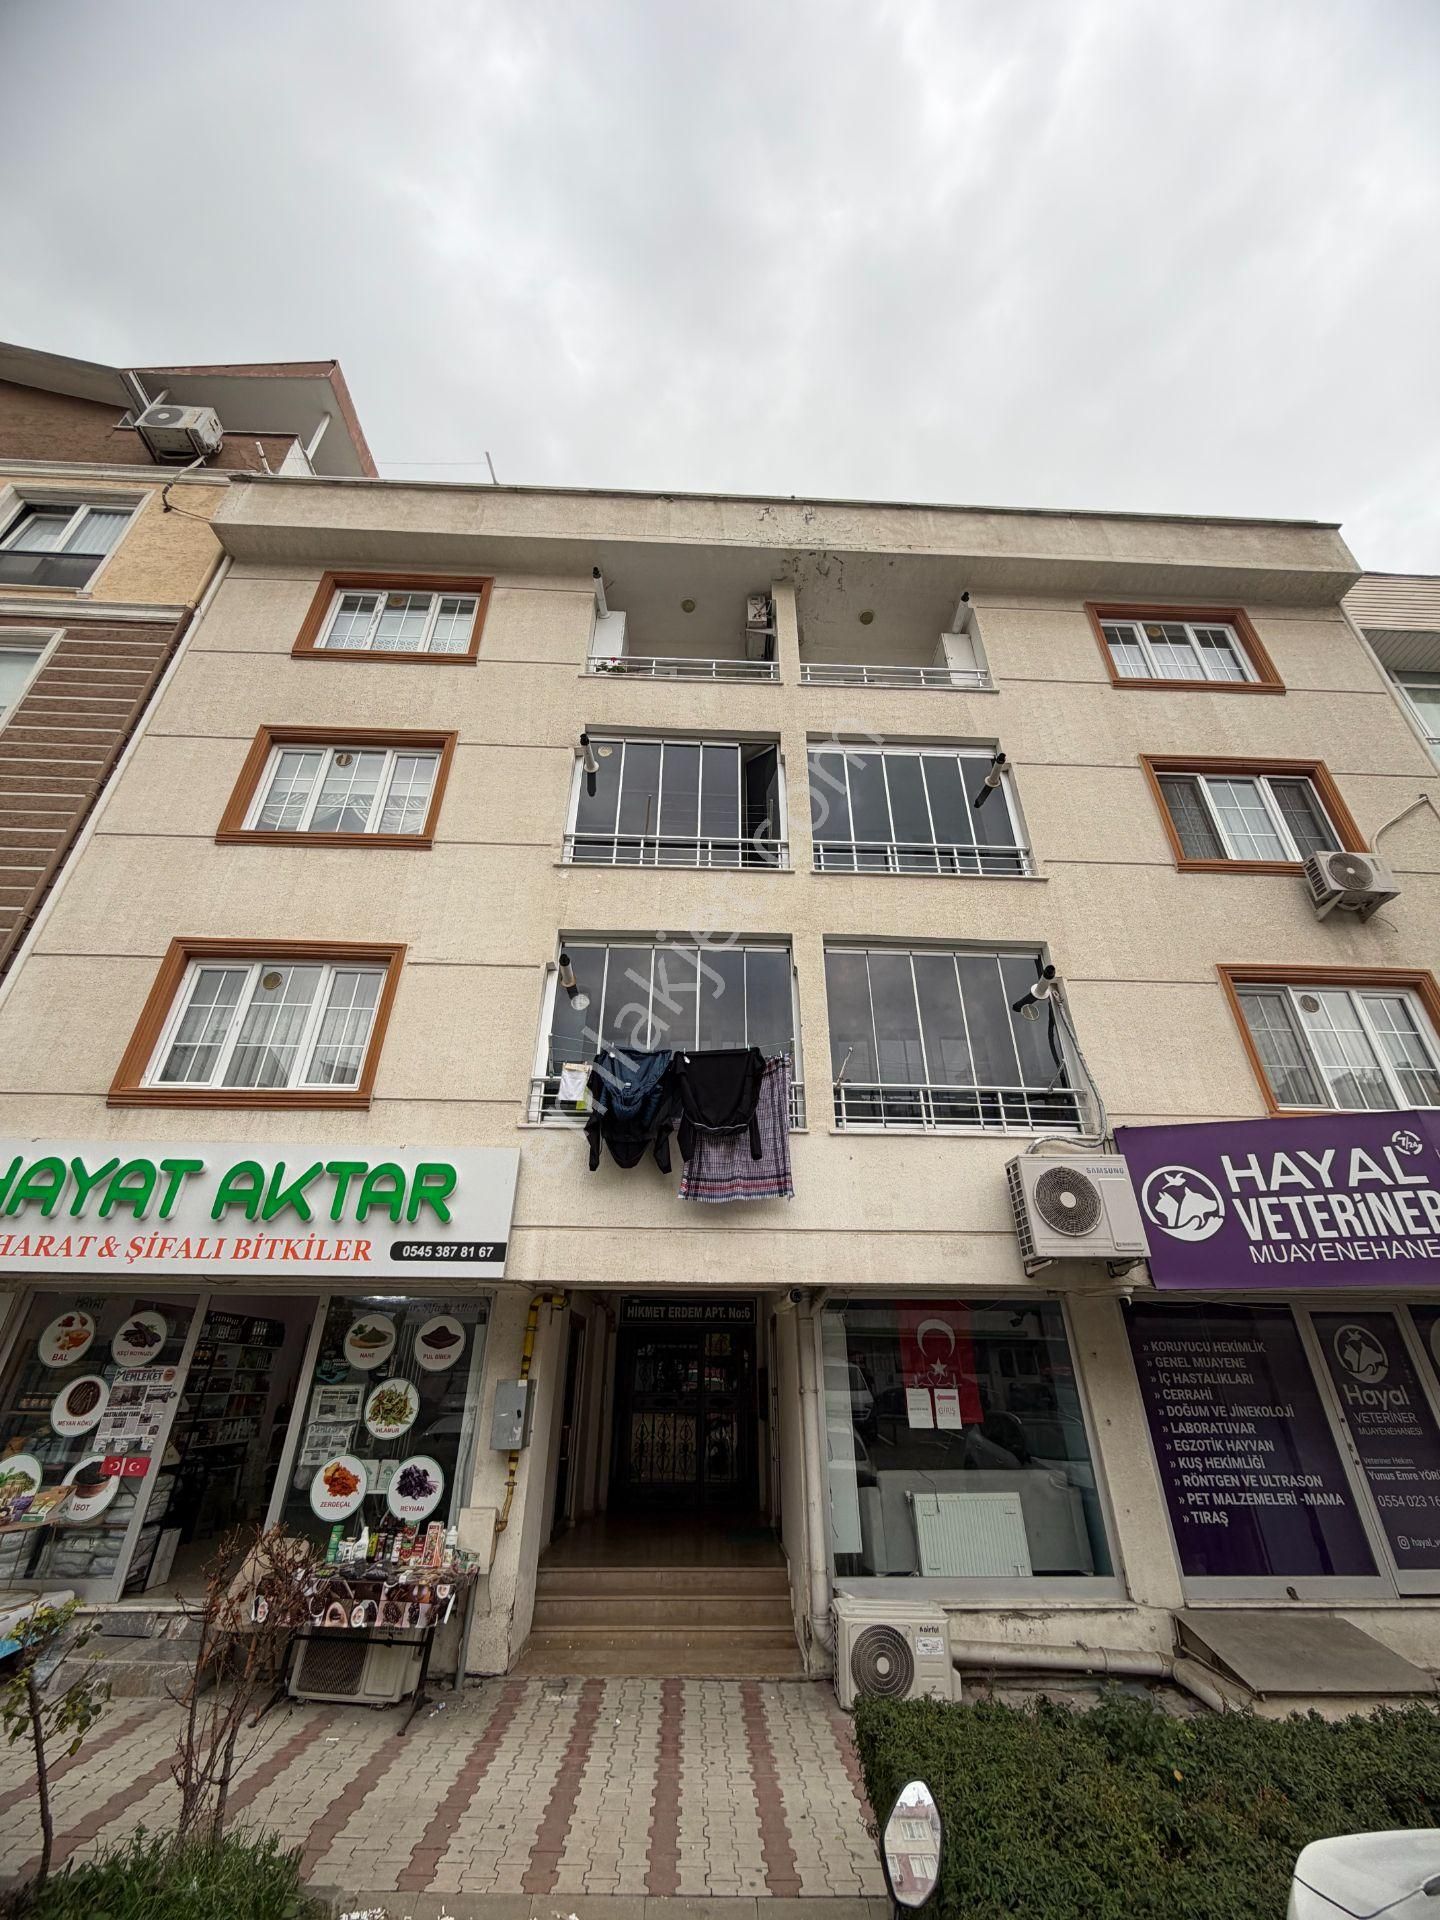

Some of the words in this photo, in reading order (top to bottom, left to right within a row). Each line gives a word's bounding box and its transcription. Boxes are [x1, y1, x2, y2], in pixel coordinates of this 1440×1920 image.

[1085, 1167, 1125, 1175] SAMSUNG
[1220, 1146, 1430, 1193] HAYAL
[210, 1159, 460, 1224] AKTAR
[97, 1236, 121, 1258] &
[126, 1231, 227, 1264] ŞİFALI
[230, 1232, 374, 1262] BİTKİLER
[402, 1245, 433, 1257] 0545
[435, 1246, 458, 1257] 387
[460, 1246, 475, 1257] 81
[478, 1246, 495, 1258] 67
[1249, 1240, 1440, 1264] MUAYENEHANE
[667, 1306, 704, 1319] ERDEM
[703, 1307, 726, 1319] APT.
[728, 1307, 751, 1319] No:6
[1150, 1341, 1211, 1352] KORUYUCU
[1212, 1339, 1267, 1353] HEKİMLİK
[52, 1353, 69, 1361] BAL
[1155, 1357, 1192, 1368] GENEL
[1191, 1357, 1247, 1368] MUAYENE
[1157, 1370, 1171, 1386] İÇ
[1172, 1373, 1255, 1384] HASTALIKLARI
[1162, 1387, 1214, 1401] CERRAHİ
[1342, 1384, 1411, 1411] Hayal
[1166, 1403, 1210, 1417] DOĞUM
[1210, 1405, 1230, 1417] VE
[1229, 1403, 1296, 1418] JİNEKOLOJİ
[1353, 1411, 1419, 1424] VETERİNER
[1170, 1422, 1257, 1434] LABORATUVAR
[1173, 1437, 1224, 1451] EGZOTİK
[1225, 1440, 1275, 1452] HAYVAN
[1178, 1457, 1204, 1472] KUŞ
[1204, 1454, 1266, 1469] HEKİMLİĞİ
[1181, 1473, 1241, 1487] RÖNTGEN
[1241, 1475, 1260, 1487] VE
[1259, 1475, 1325, 1488] ULTRASON
[1368, 1471, 1396, 1481] Yunus
[1395, 1471, 1419, 1481] Emre
[1186, 1493, 1210, 1506] PET
[1212, 1490, 1298, 1506] MALZEMELERİ
[1377, 1495, 1406, 1507] 0554
[1406, 1495, 1428, 1508] 023
[1190, 1510, 1229, 1527] TIRAŞ
